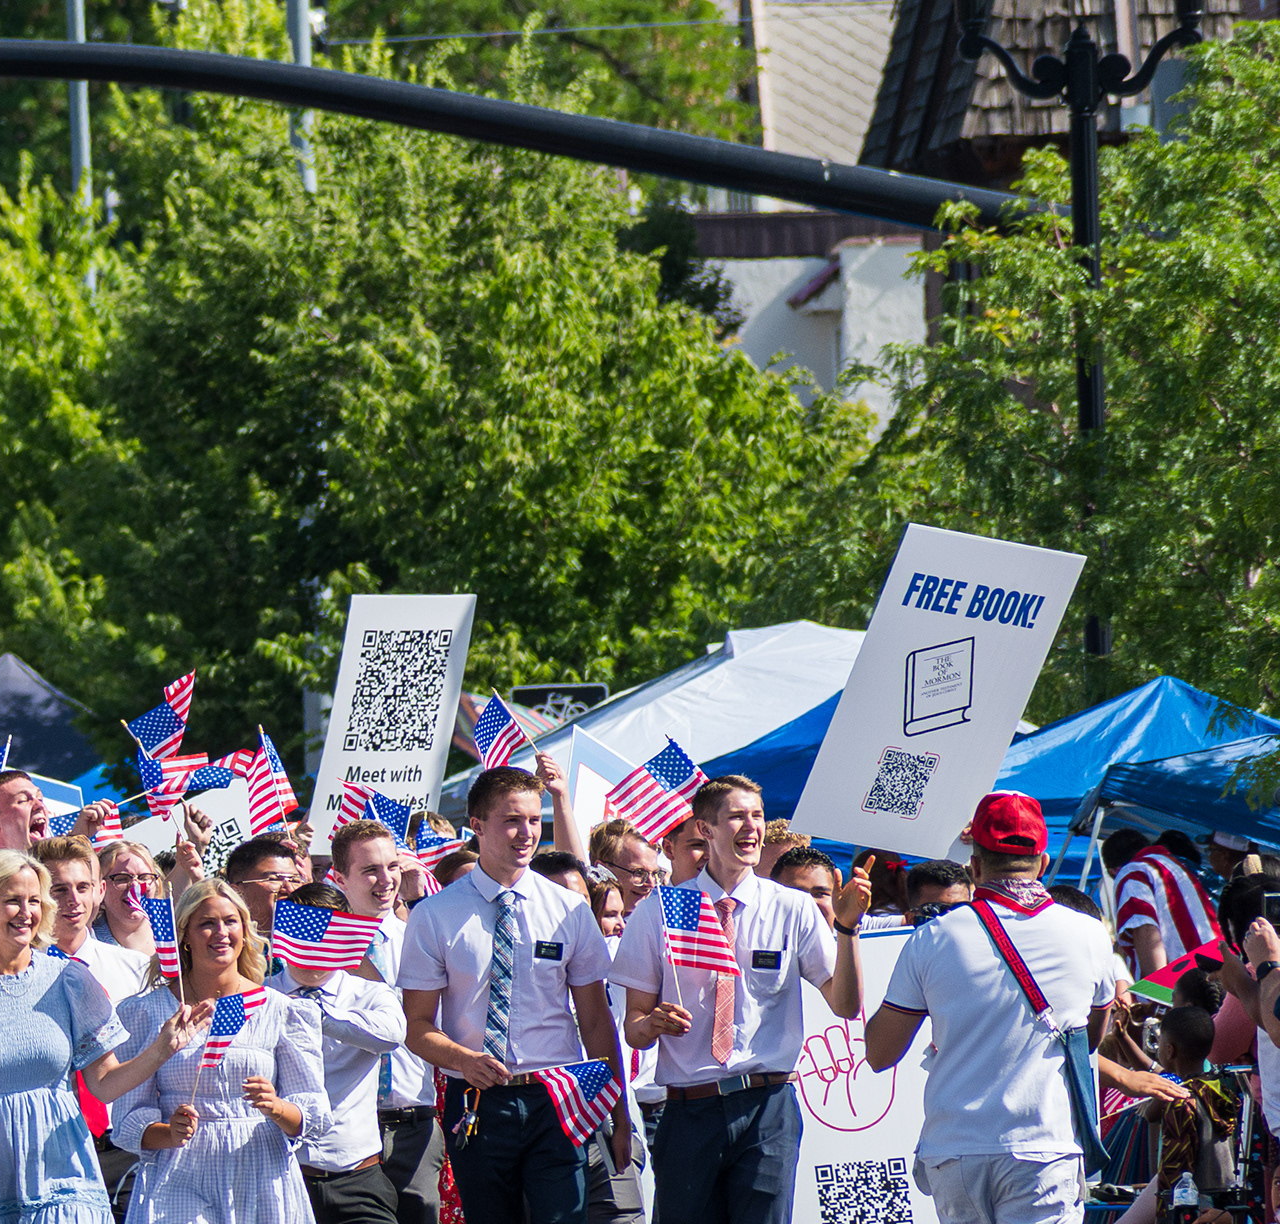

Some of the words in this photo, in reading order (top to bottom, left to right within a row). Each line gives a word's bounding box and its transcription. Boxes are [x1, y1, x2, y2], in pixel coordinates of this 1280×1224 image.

[901, 572, 969, 616] FREE
[965, 584, 1046, 629] BOOK!
[932, 661, 953, 671] BOOK
[924, 671, 961, 686] MORMON
[345, 766, 387, 783] Meet
[390, 765, 422, 783] with
